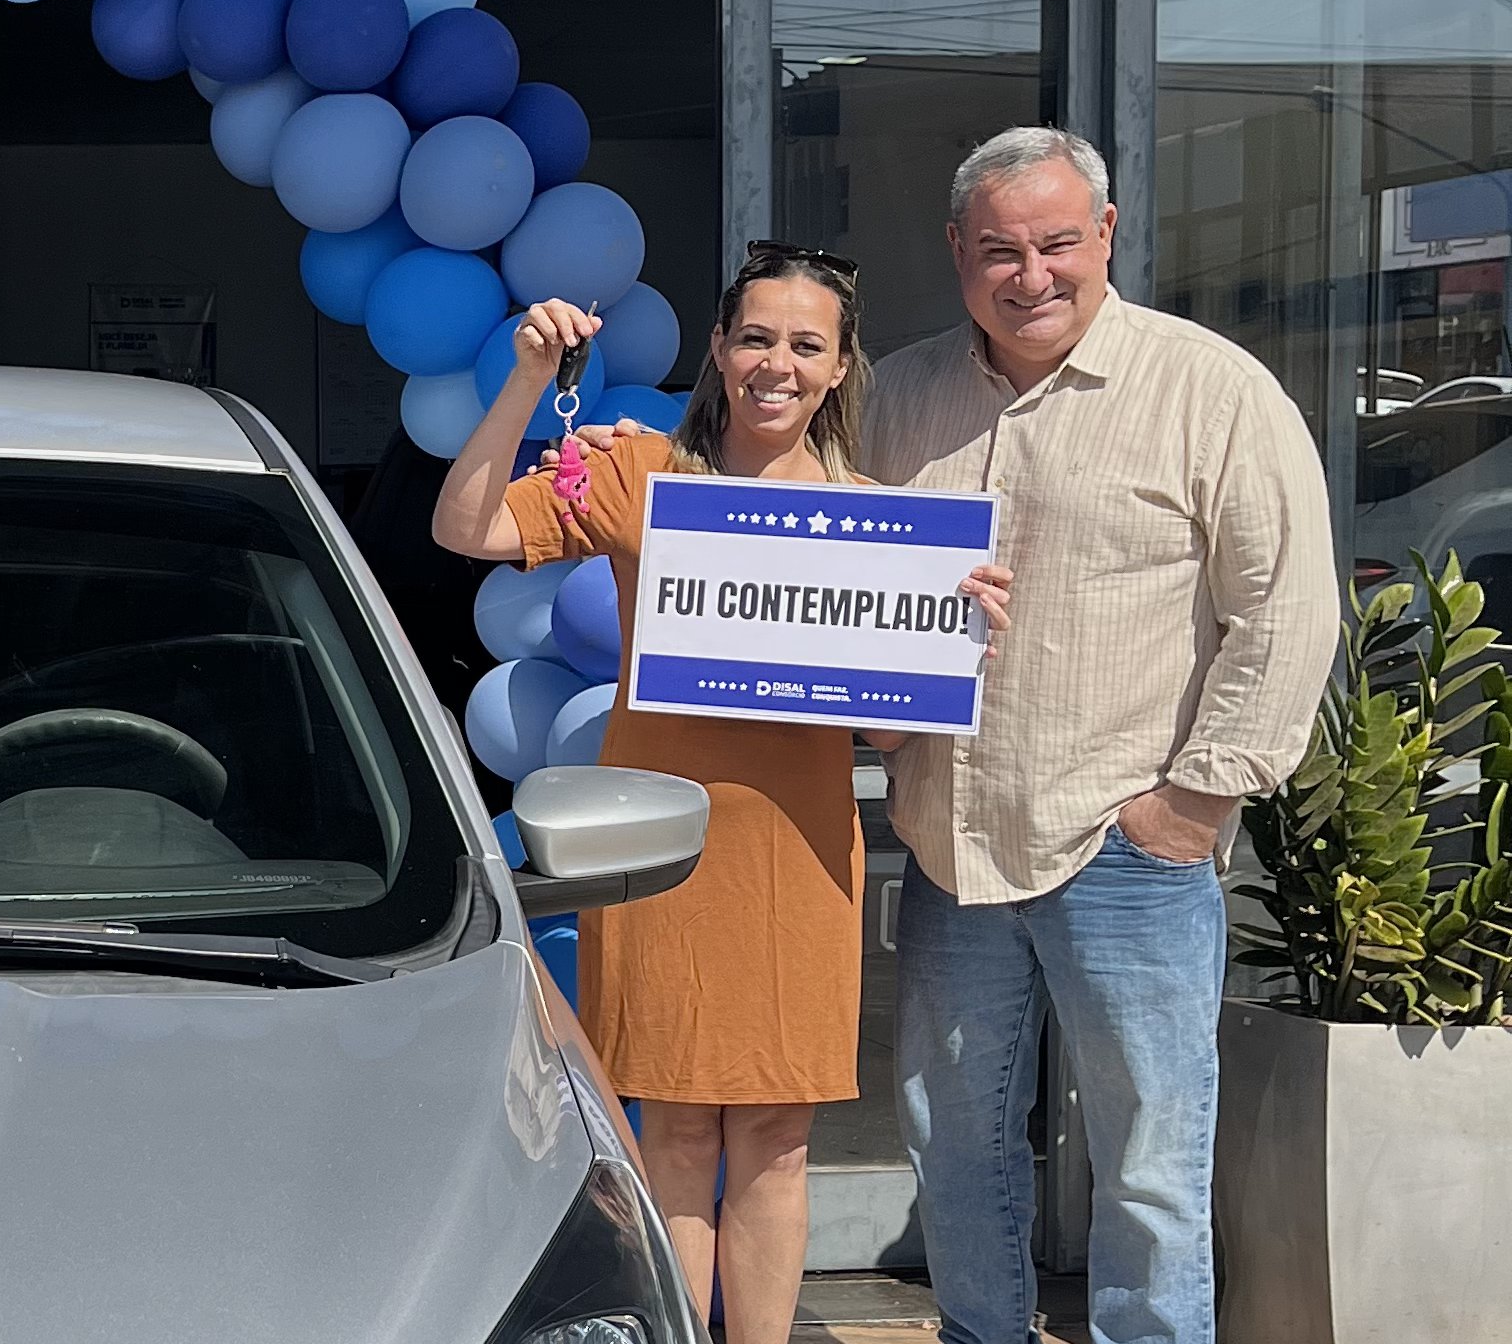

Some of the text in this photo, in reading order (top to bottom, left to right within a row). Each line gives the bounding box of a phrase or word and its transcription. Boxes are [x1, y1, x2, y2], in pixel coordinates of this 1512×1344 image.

[657, 576, 971, 635] FUI CONTEMPLADO!
[772, 681, 806, 693] DISAL
